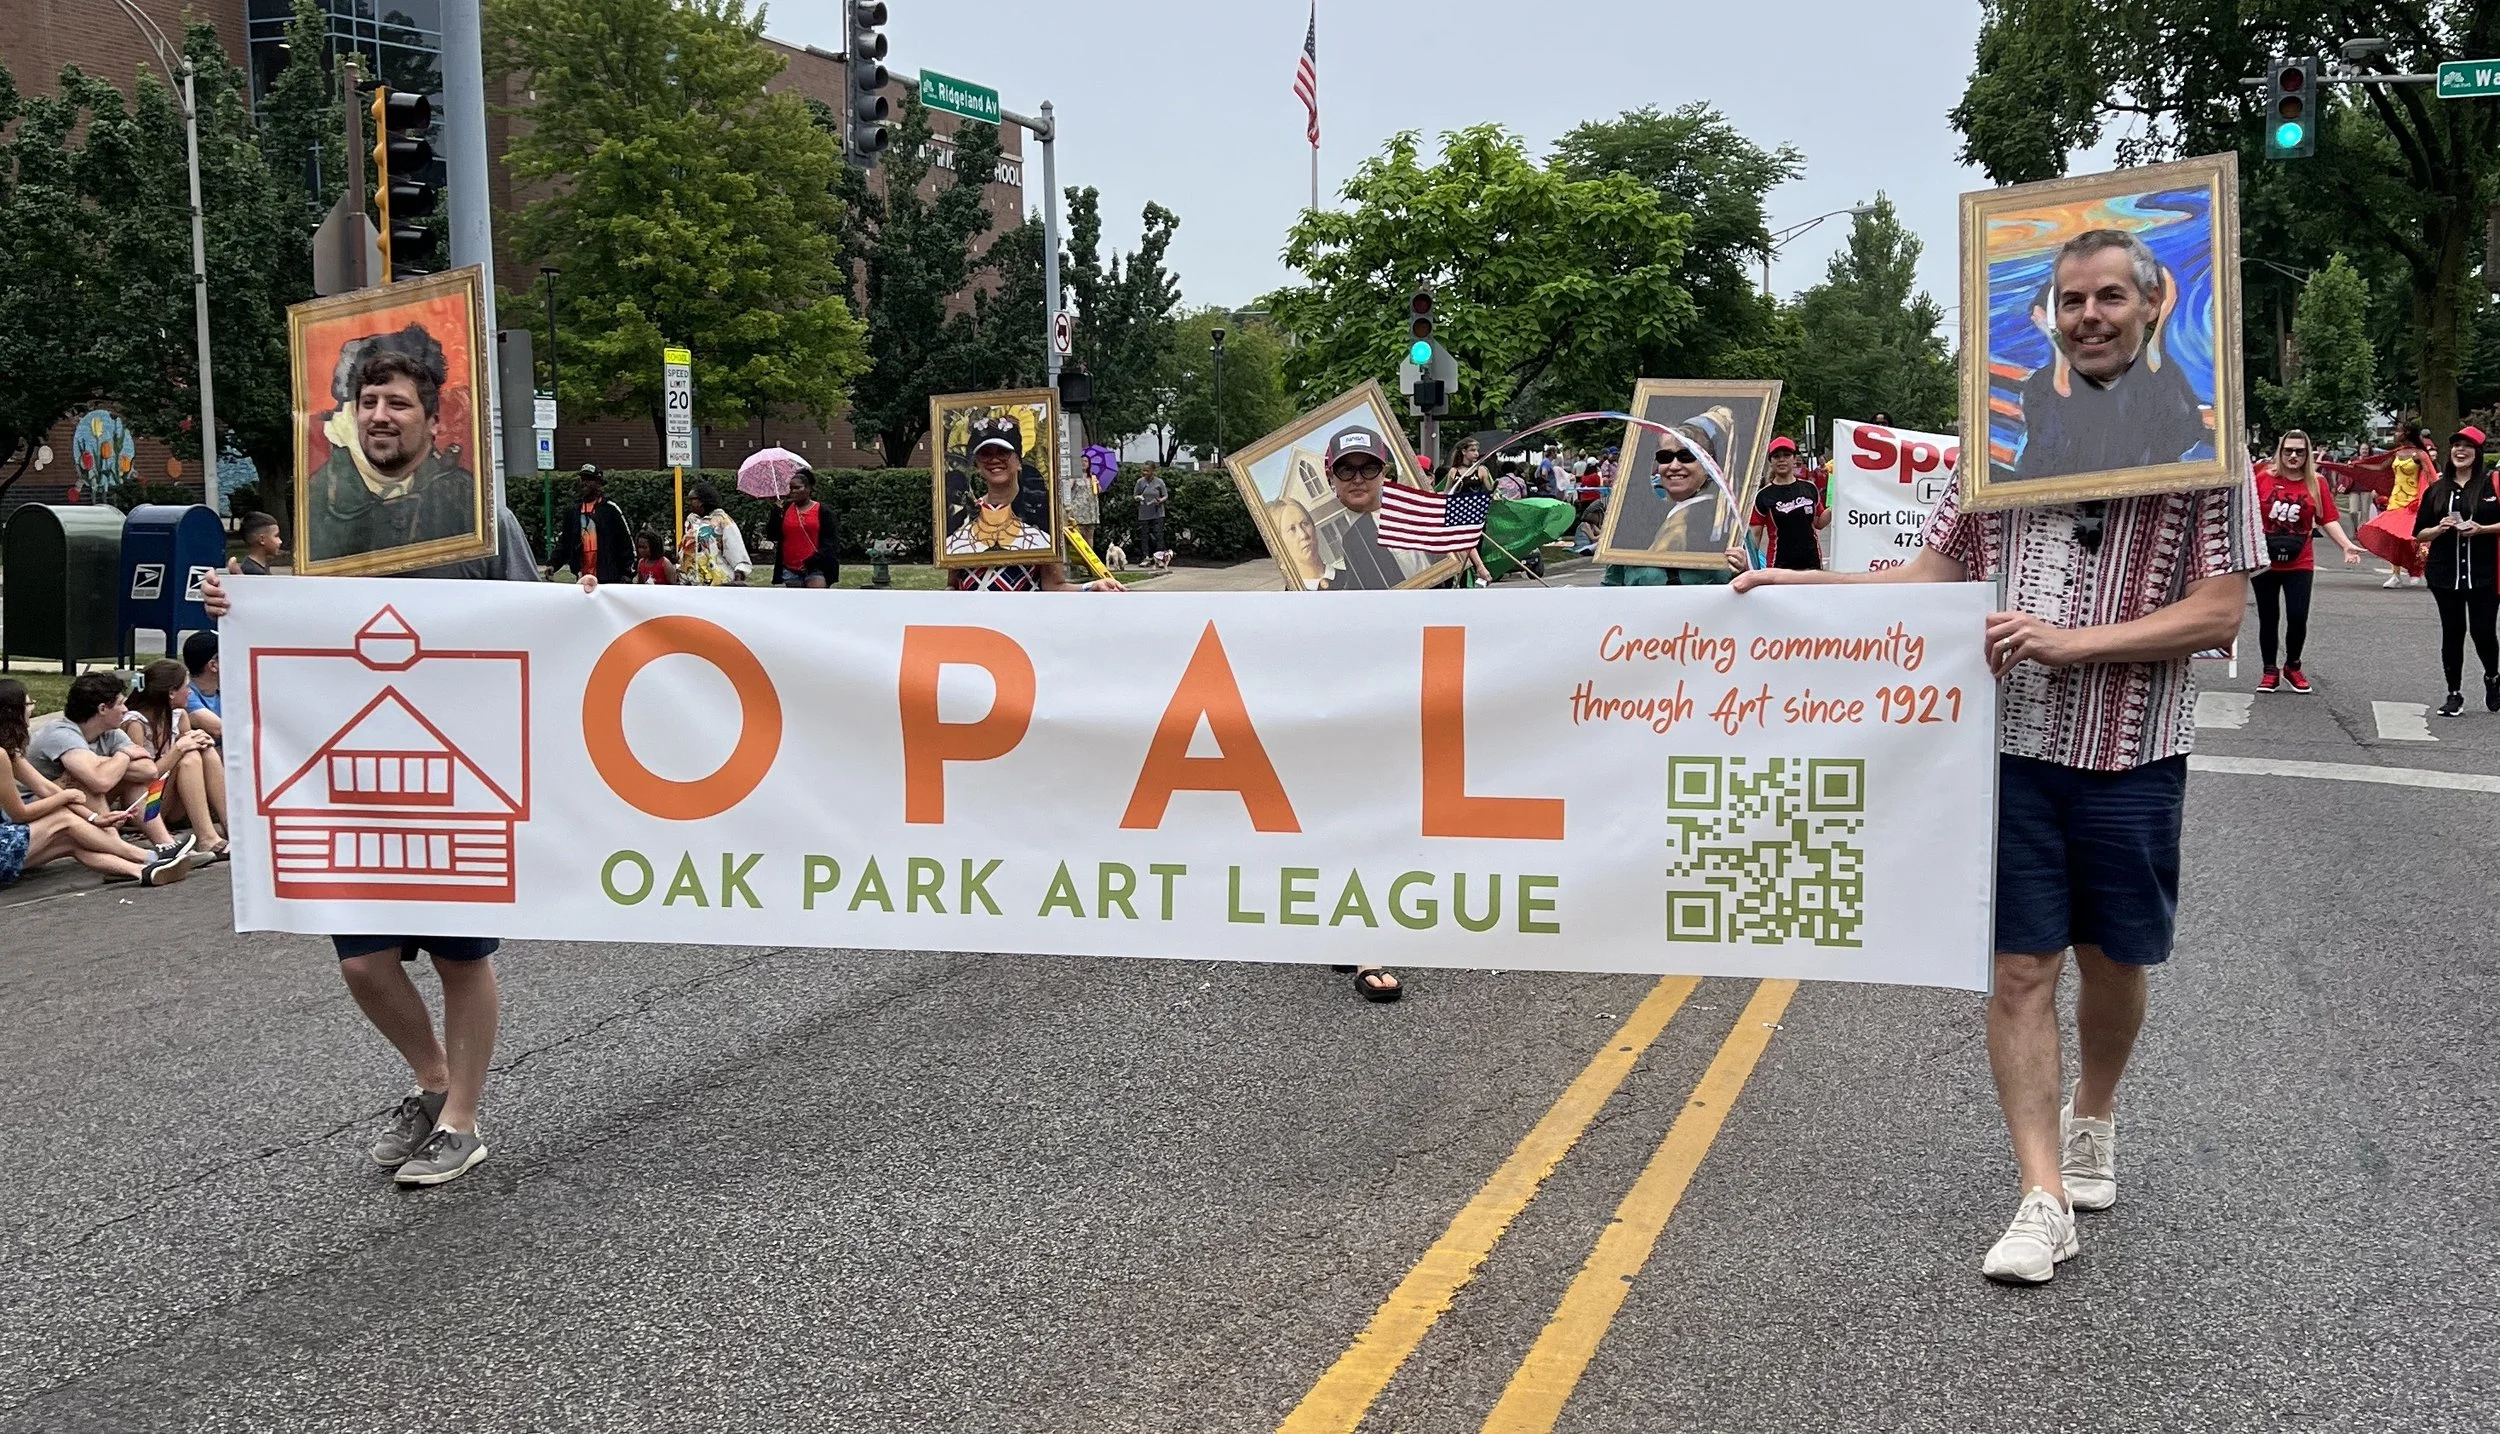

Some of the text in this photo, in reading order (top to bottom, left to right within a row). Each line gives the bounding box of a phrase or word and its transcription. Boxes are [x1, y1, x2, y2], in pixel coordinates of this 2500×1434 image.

[938, 82, 997, 115] Ridgeland Av
[987, 162, 1022, 187] HOOL
[667, 369, 689, 378] SPEED
[669, 380, 687, 388] LIMIT
[668, 390, 689, 410] 20
[671, 440, 688, 449] FINES
[669, 453, 690, 461] HIGHER
[1848, 510, 1891, 528] Sport
[2268, 500, 2301, 522] ME
[1894, 533, 1924, 547] 473
[1600, 621, 1925, 673] Creating community
[1569, 679, 1962, 736] through Art since 1921
[582, 615, 1564, 839] OPAL
[600, 849, 1561, 934] OAK PARK ART LEAGUE
